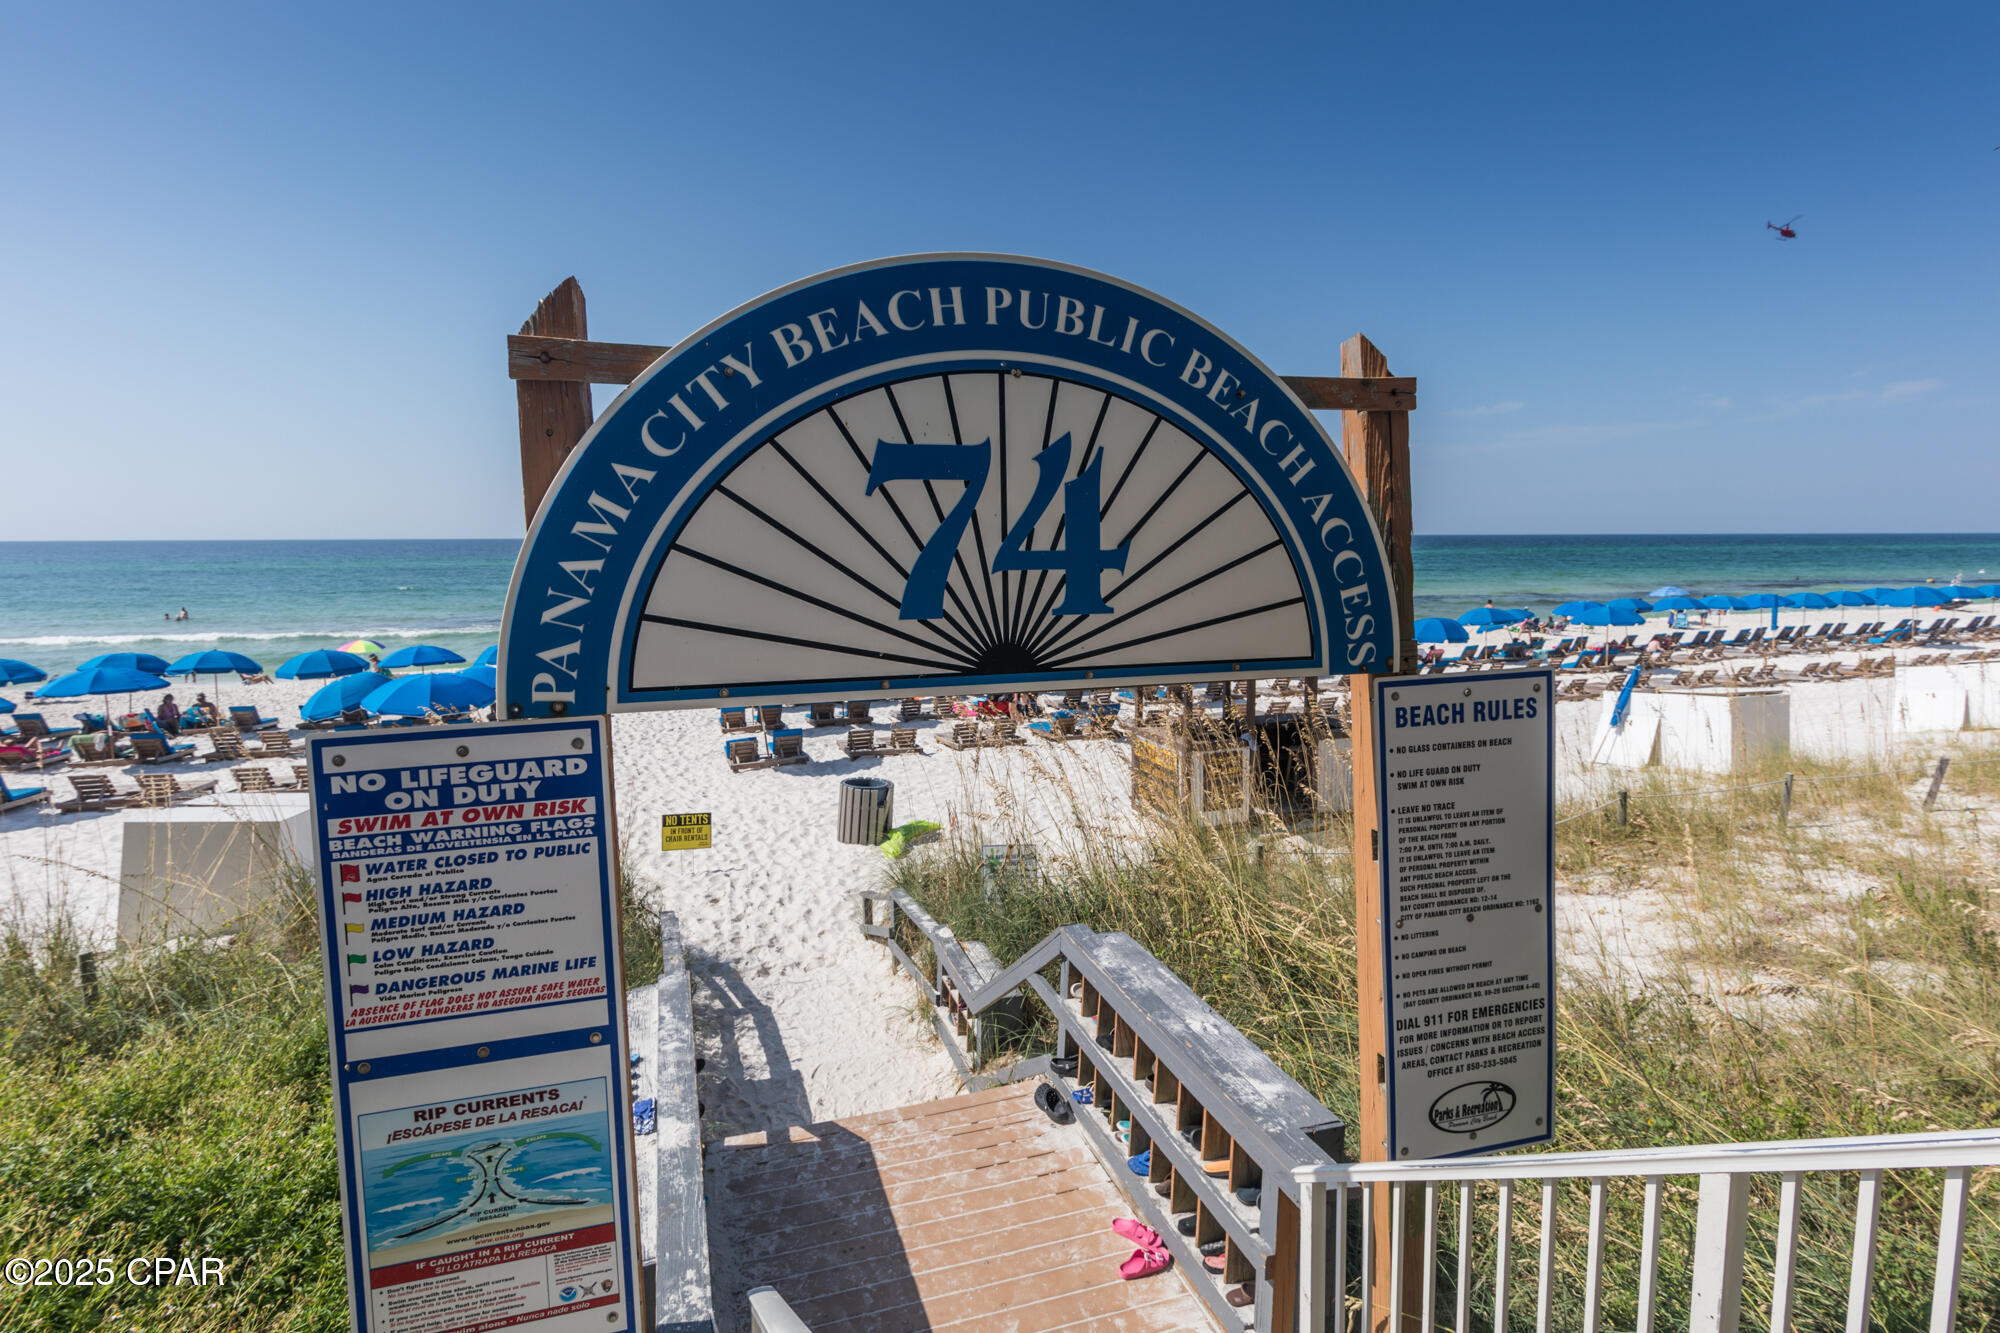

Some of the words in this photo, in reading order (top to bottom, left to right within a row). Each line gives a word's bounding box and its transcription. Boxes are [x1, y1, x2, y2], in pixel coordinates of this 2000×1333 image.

[531, 461, 658, 704] PANAMA
[641, 342, 763, 457] CITY
[769, 286, 967, 369] BEACH
[985, 286, 1176, 367] PUBLIC
[1179, 348, 1318, 487] BEACH
[1302, 492, 1378, 668] ACCESS
[865, 431, 1133, 620] 74
[1395, 702, 1464, 728] BEACH
[1473, 696, 1537, 722] RULES
[1396, 745, 1406, 754] NO
[1408, 743, 1430, 753] GLASS
[1432, 740, 1476, 751] CONTAINERS
[1477, 739, 1487, 748] ON
[1489, 737, 1512, 747] BEACH
[330, 773, 386, 795] NO
[400, 757, 588, 789] LIFEGUARD
[1396, 770, 1407, 778] NO
[1408, 768, 1424, 778] LIFE
[1425, 766, 1450, 776] GUARD
[1451, 765, 1461, 774] ON
[1462, 763, 1481, 773] DUTY
[1397, 781, 1418, 791] SWIM
[1419, 780, 1428, 788] AT
[1430, 778, 1447, 788] OWN
[1448, 777, 1464, 786] RISK
[384, 788, 439, 810] ON
[452, 780, 541, 805] DUTY
[1397, 805, 1419, 815] LEAVE
[1421, 804, 1431, 812] NO
[1433, 801, 1455, 811] TRACE
[337, 813, 411, 835] SWIM
[420, 809, 454, 827] AT
[461, 803, 525, 823] OWN
[533, 798, 587, 817] RISK
[665, 815, 678, 826] NO
[680, 813, 709, 825] TENTS
[328, 834, 402, 852] BEACH
[410, 823, 522, 843] WARNING
[530, 816, 595, 833] FLAGS
[332, 846, 402, 859] BANDERAS
[406, 844, 423, 852] DE
[427, 835, 512, 850] ADVERTENSIA
[515, 833, 532, 842] EN
[536, 832, 551, 840] LA
[554, 828, 593, 838] PLAYA
[365, 858, 427, 876] WATER
[434, 851, 499, 869] CLOSED
[505, 848, 527, 861] TO
[533, 842, 591, 859] PUBLIC
[365, 885, 412, 902] HIGH
[418, 877, 492, 896] HAZARD
[370, 911, 446, 931] MEDIUM
[452, 902, 525, 922] HAZARD
[1410, 929, 1439, 940] LITTERING
[372, 946, 415, 963] LOW
[421, 937, 494, 957] HAZARD
[1411, 949, 1437, 959] CAMPING
[1447, 945, 1467, 954] BEACH
[375, 969, 486, 995] DANGEROUS
[491, 960, 559, 980] MARINE
[564, 956, 597, 971] LIFE
[1411, 970, 1427, 978] OPEN
[1427, 967, 1444, 975] FIRES
[1445, 963, 1470, 973] WITHOUT
[1471, 960, 1492, 969] PERMIT
[344, 1018, 356, 1028] LA
[358, 1011, 406, 1025] AUSENCIA
[408, 1009, 422, 1019] DE
[424, 1002, 474, 1016] BANDERAS
[476, 1000, 489, 1009] NO
[491, 994, 533, 1007] ASEGURA
[534, 990, 564, 1001] AGUAS
[565, 985, 606, 998] SEGURAS
[350, 1002, 400, 1018] ABSENCE
[402, 1000, 417, 1011] OF
[419, 997, 444, 1008] FLAG
[446, 993, 475, 1005] DOES
[477, 990, 498, 1001] NOT
[498, 984, 538, 998] ASSURE
[539, 981, 565, 993] SAFE
[567, 976, 600, 989] WATER
[1396, 1017, 1421, 1031] DIAL
[1423, 1013, 1443, 1027] 911
[1447, 1009, 1468, 1023] FOR
[1471, 997, 1545, 1019] EMERGENCIES
[1399, 1034, 1414, 1044] FOR
[1416, 1030, 1438, 1042] MORE
[1439, 1022, 1490, 1038] INFORMATION
[1491, 1020, 1502, 1030] OR
[1503, 1018, 1513, 1028] TO
[1514, 1014, 1543, 1026] REPORT
[1396, 1045, 1423, 1058] ISSUES
[1430, 1038, 1470, 1052] CONCERNS
[1471, 1035, 1490, 1045] WITH
[1492, 1030, 1516, 1042] BEACH
[1517, 1026, 1545, 1038] ACCESS
[1401, 1058, 1428, 1070] AREAS,
[1429, 1051, 1463, 1065] CONTACT
[1464, 1047, 1489, 1059] PARKS
[1490, 1046, 1496, 1055] &
[1497, 1039, 1542, 1054] RECREATION
[1427, 1066, 1453, 1078] OFFICE
[1455, 1064, 1465, 1073] AT
[1466, 1055, 1517, 1071] 850-233-5045
[413, 1106, 447, 1123] RIP
[453, 1088, 560, 1116] CURRENTS
[474, 1114, 496, 1127] DE
[498, 1111, 517, 1123] LA
[520, 1100, 583, 1120] RESACA!
[1434, 1107, 1454, 1122] Parks
[1462, 1100, 1499, 1117] Recreation
[415, 1261, 426, 1270] IF
[429, 1252, 475, 1267] CAUGHT
[478, 1249, 490, 1257] IN
[493, 1247, 501, 1255] A
[503, 1243, 522, 1252] RIP
[524, 1232, 575, 1248] CURRENT
[435, 1266, 445, 1274] SI
[446, 1263, 461, 1272] LO
[462, 1255, 501, 1269] ATRAPA
[502, 1252, 516, 1261] LA
[517, 1244, 557, 1258] RESACA
